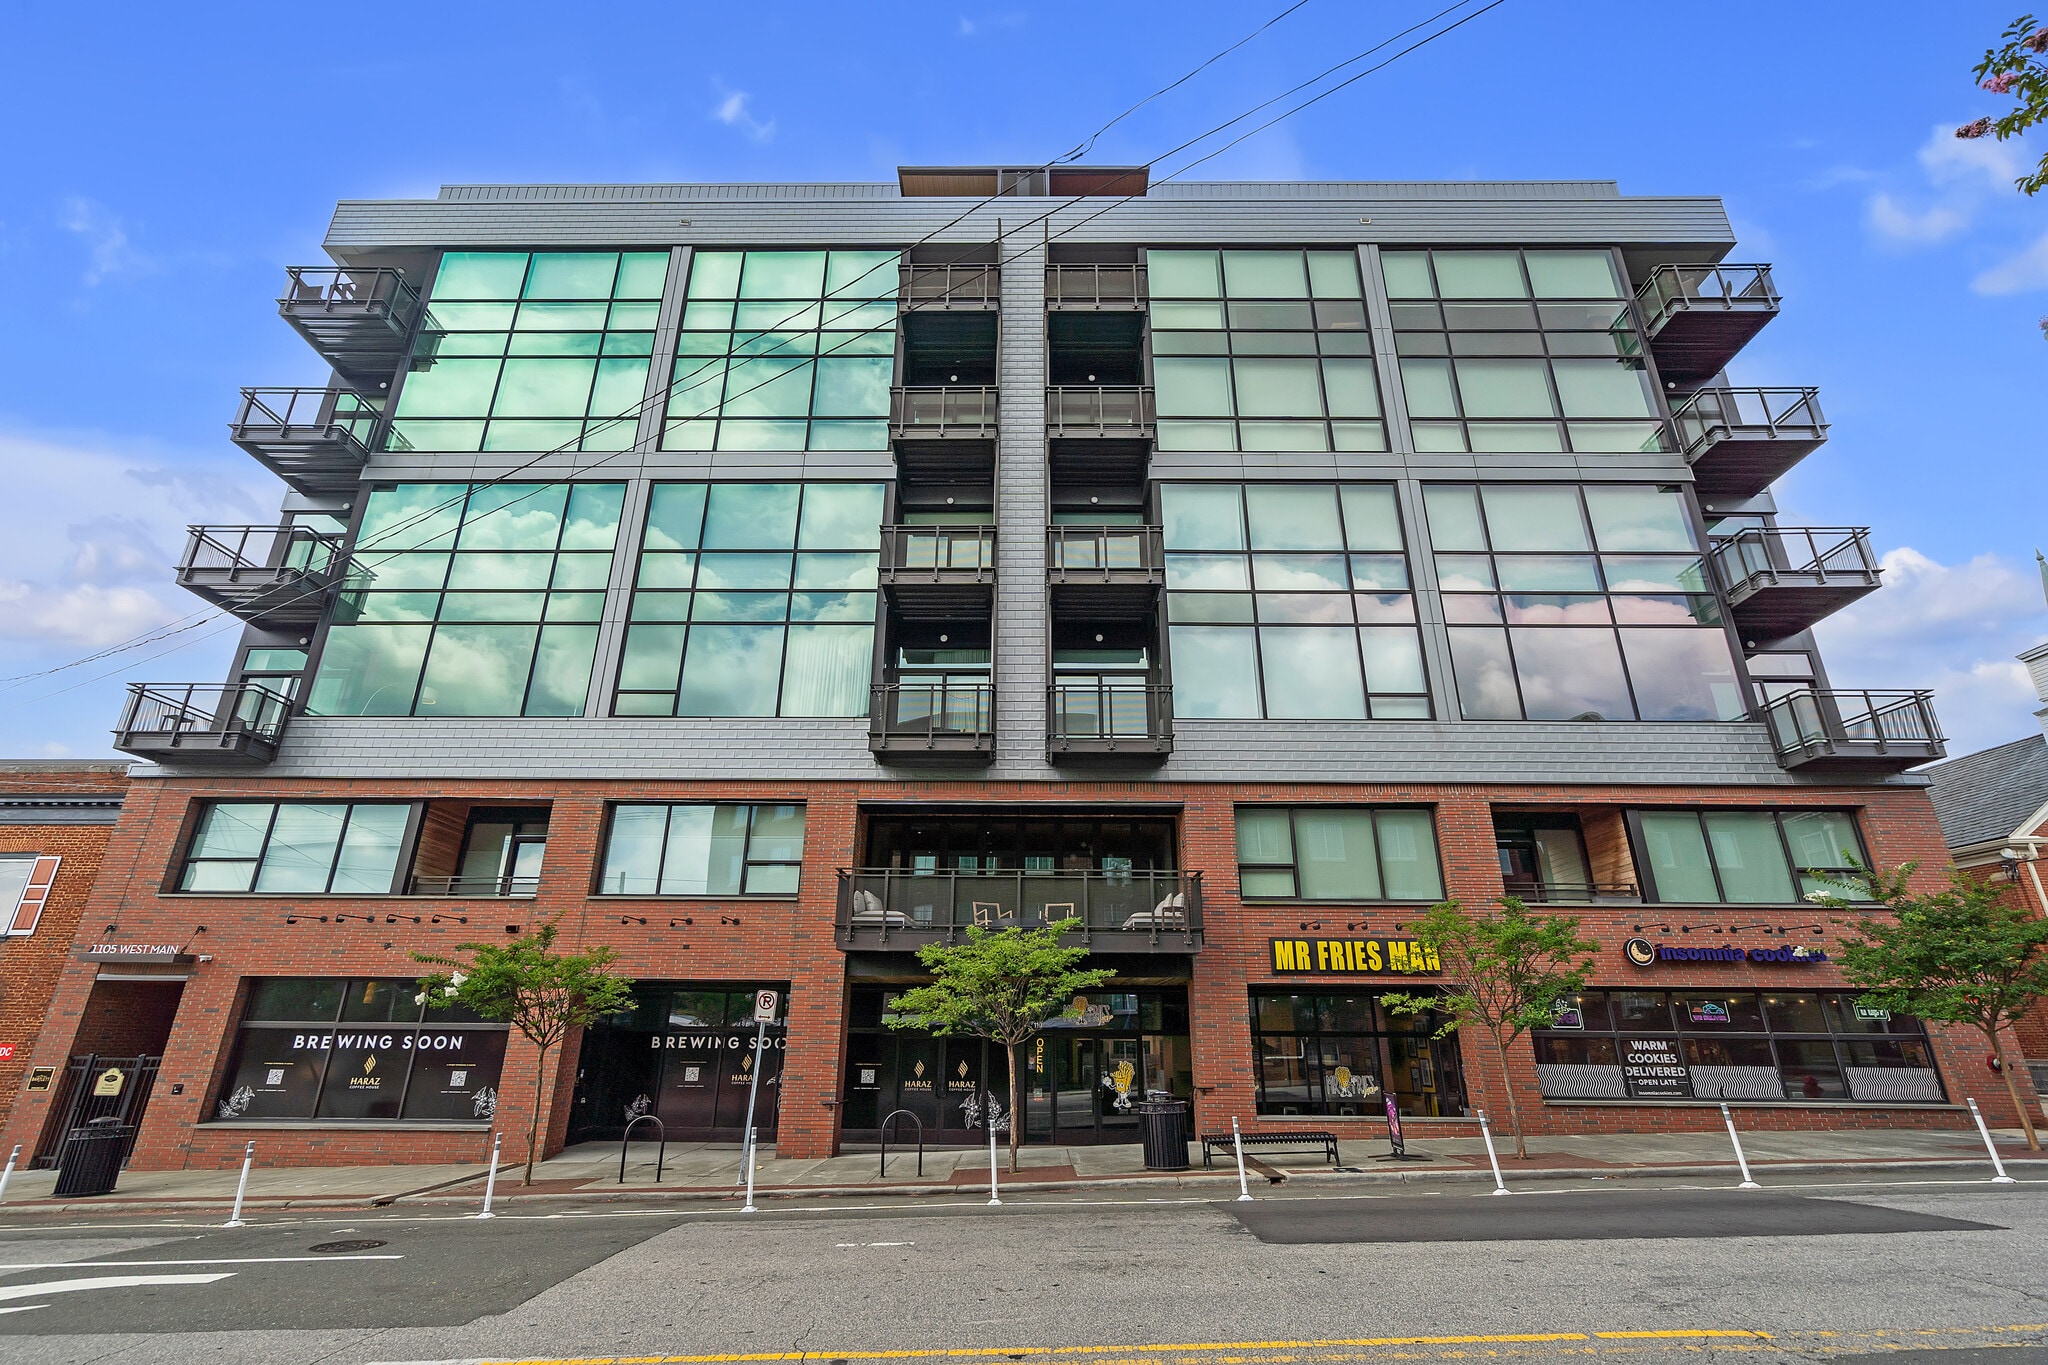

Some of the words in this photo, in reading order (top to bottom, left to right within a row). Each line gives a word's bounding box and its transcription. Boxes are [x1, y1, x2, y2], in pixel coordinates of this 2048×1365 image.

[90, 944, 117, 954] 1105
[120, 944, 150, 954] WEST
[150, 945, 179, 954] MAIN
[1655, 944, 1746, 961] insomnia
[1274, 940, 1311, 971] MR
[1317, 940, 1383, 971] FRIES
[292, 1035, 393, 1050] BREWING
[402, 1035, 463, 1050] SOON
[651, 1036, 740, 1049] BREWING
[748, 1037, 787, 1050] SOO
[1630, 1040, 1668, 1051] WARM
[1036, 1037, 1045, 1074] OPEN
[1627, 1053, 1678, 1064] COOKIES
[1625, 1066, 1686, 1077] DELIVERED
[350, 1077, 381, 1086] HARAZ
[731, 1074, 754, 1082] HARA
[904, 1080, 932, 1088] HARAZ
[948, 1081, 976, 1089] HARAZ
